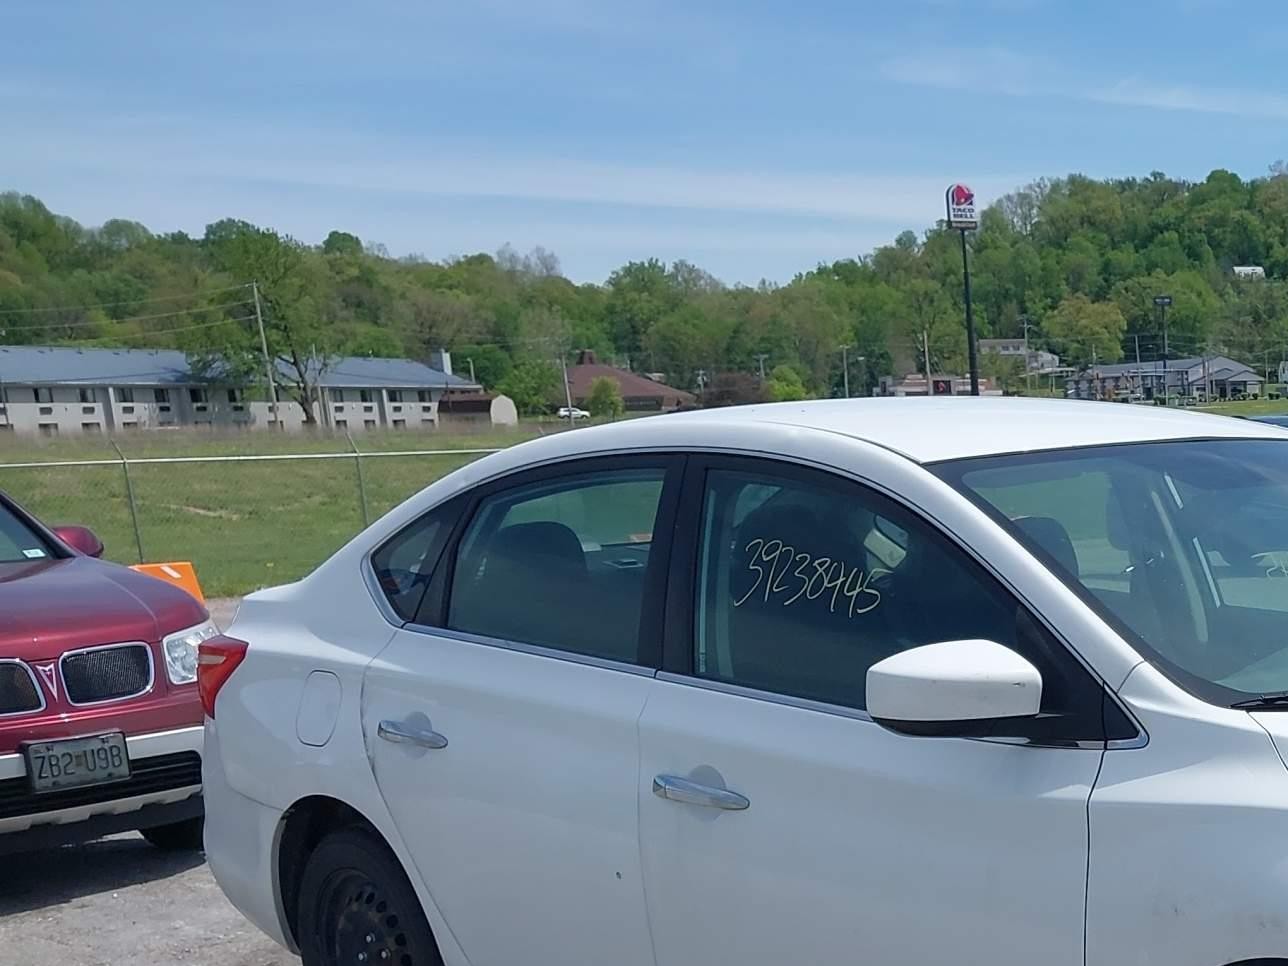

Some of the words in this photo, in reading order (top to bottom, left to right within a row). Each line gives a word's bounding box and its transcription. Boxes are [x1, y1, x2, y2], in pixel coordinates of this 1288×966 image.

[733, 538, 894, 619] 39238445
[33, 753, 76, 780] ZB2
[83, 744, 123, 772] U9B
